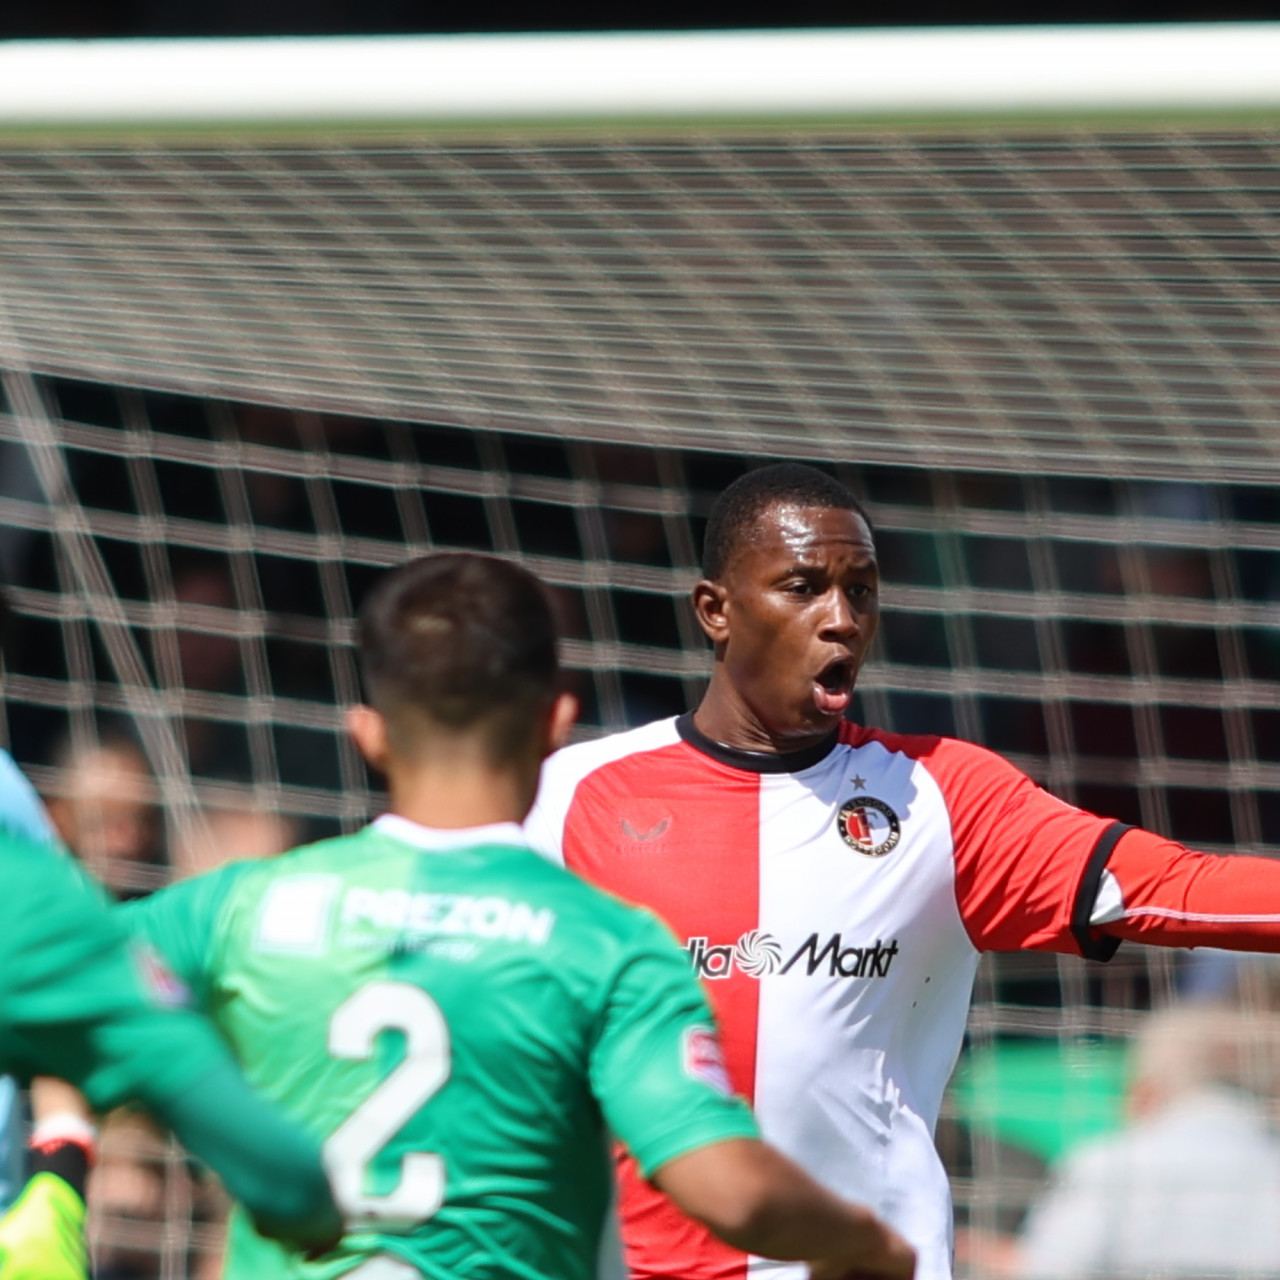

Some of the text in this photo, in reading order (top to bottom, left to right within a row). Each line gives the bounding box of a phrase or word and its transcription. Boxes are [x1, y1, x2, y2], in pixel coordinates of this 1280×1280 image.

[341, 886, 557, 946] PREZON
[778, 932, 900, 978] Markt
[324, 982, 451, 1233] 2
